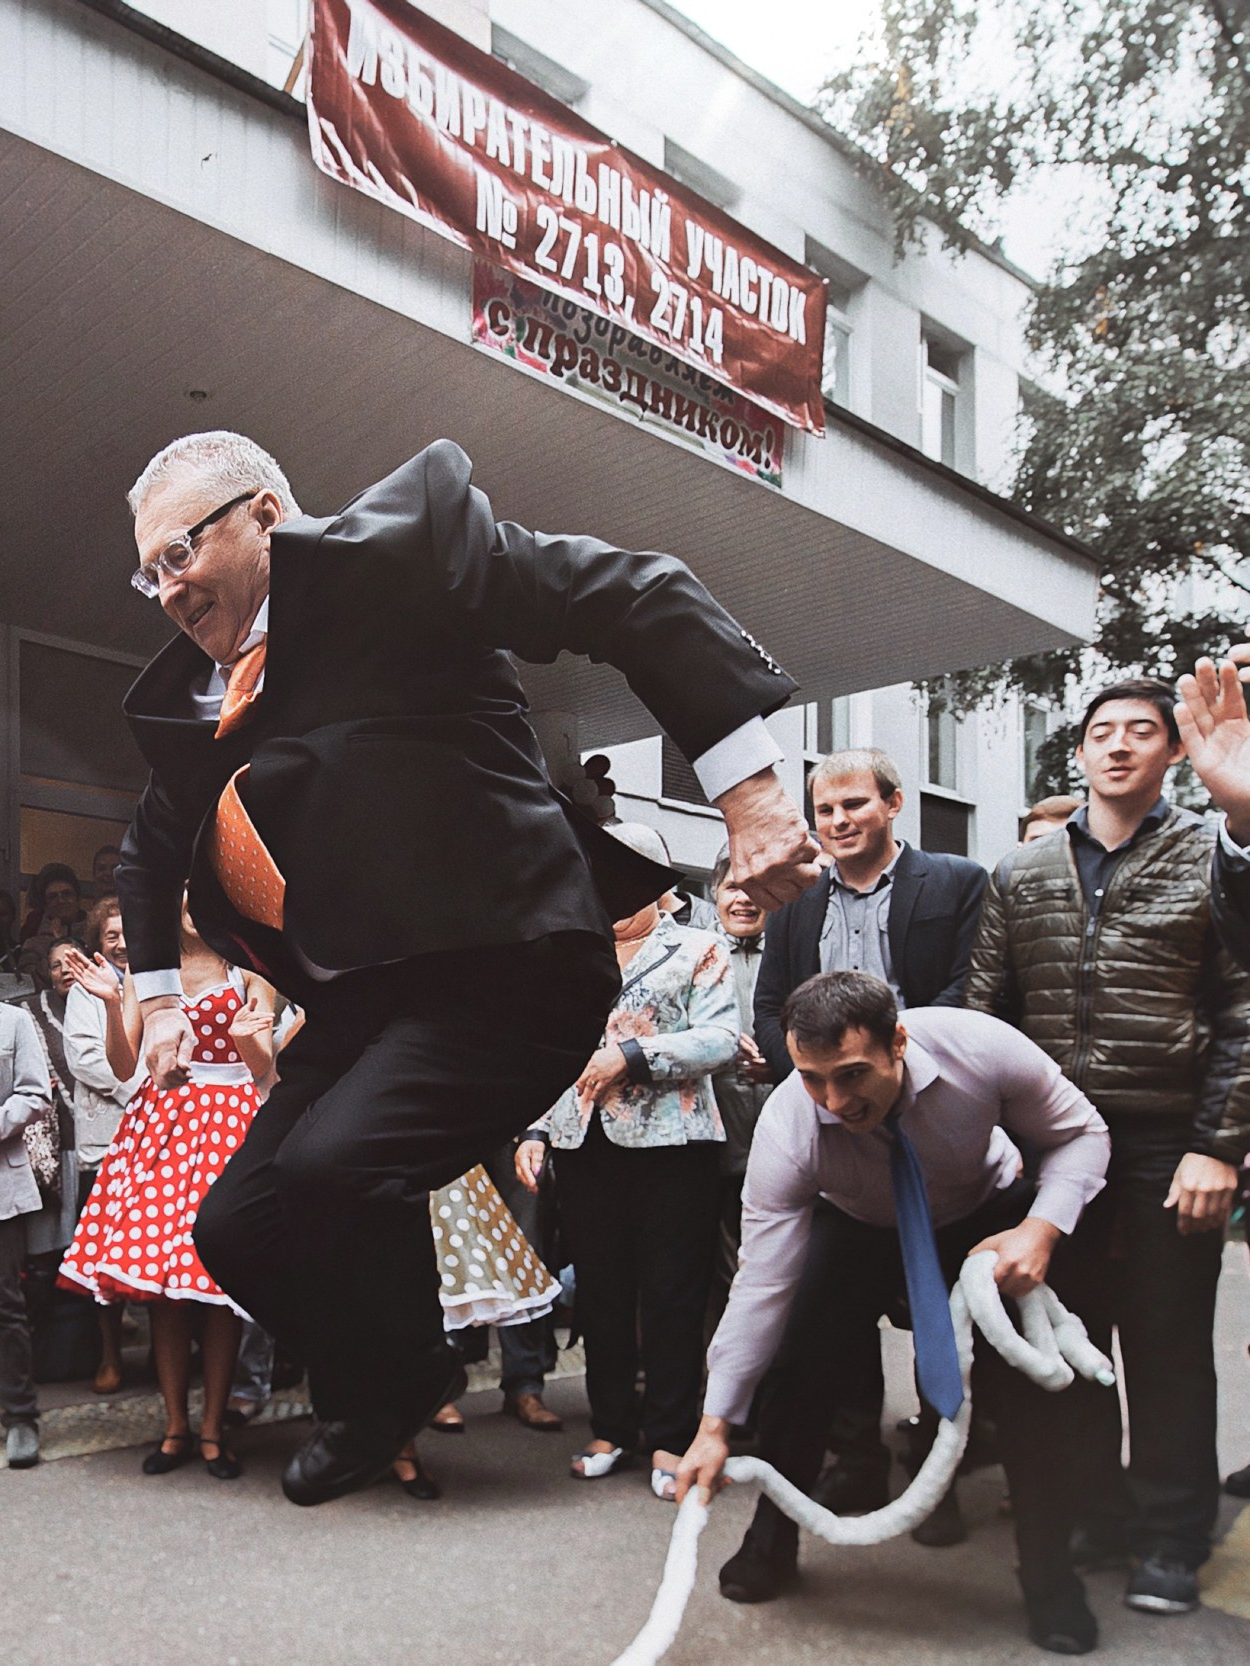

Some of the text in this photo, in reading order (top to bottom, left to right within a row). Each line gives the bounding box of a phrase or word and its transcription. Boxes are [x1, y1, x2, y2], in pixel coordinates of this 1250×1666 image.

[347, 3, 807, 346] ИЗБИРАТЕЛЬНЫЙ УЧАСТОК
[535, 204, 636, 323] 2713,
[651, 270, 724, 365] 2714
[521, 317, 776, 470] праздником!
